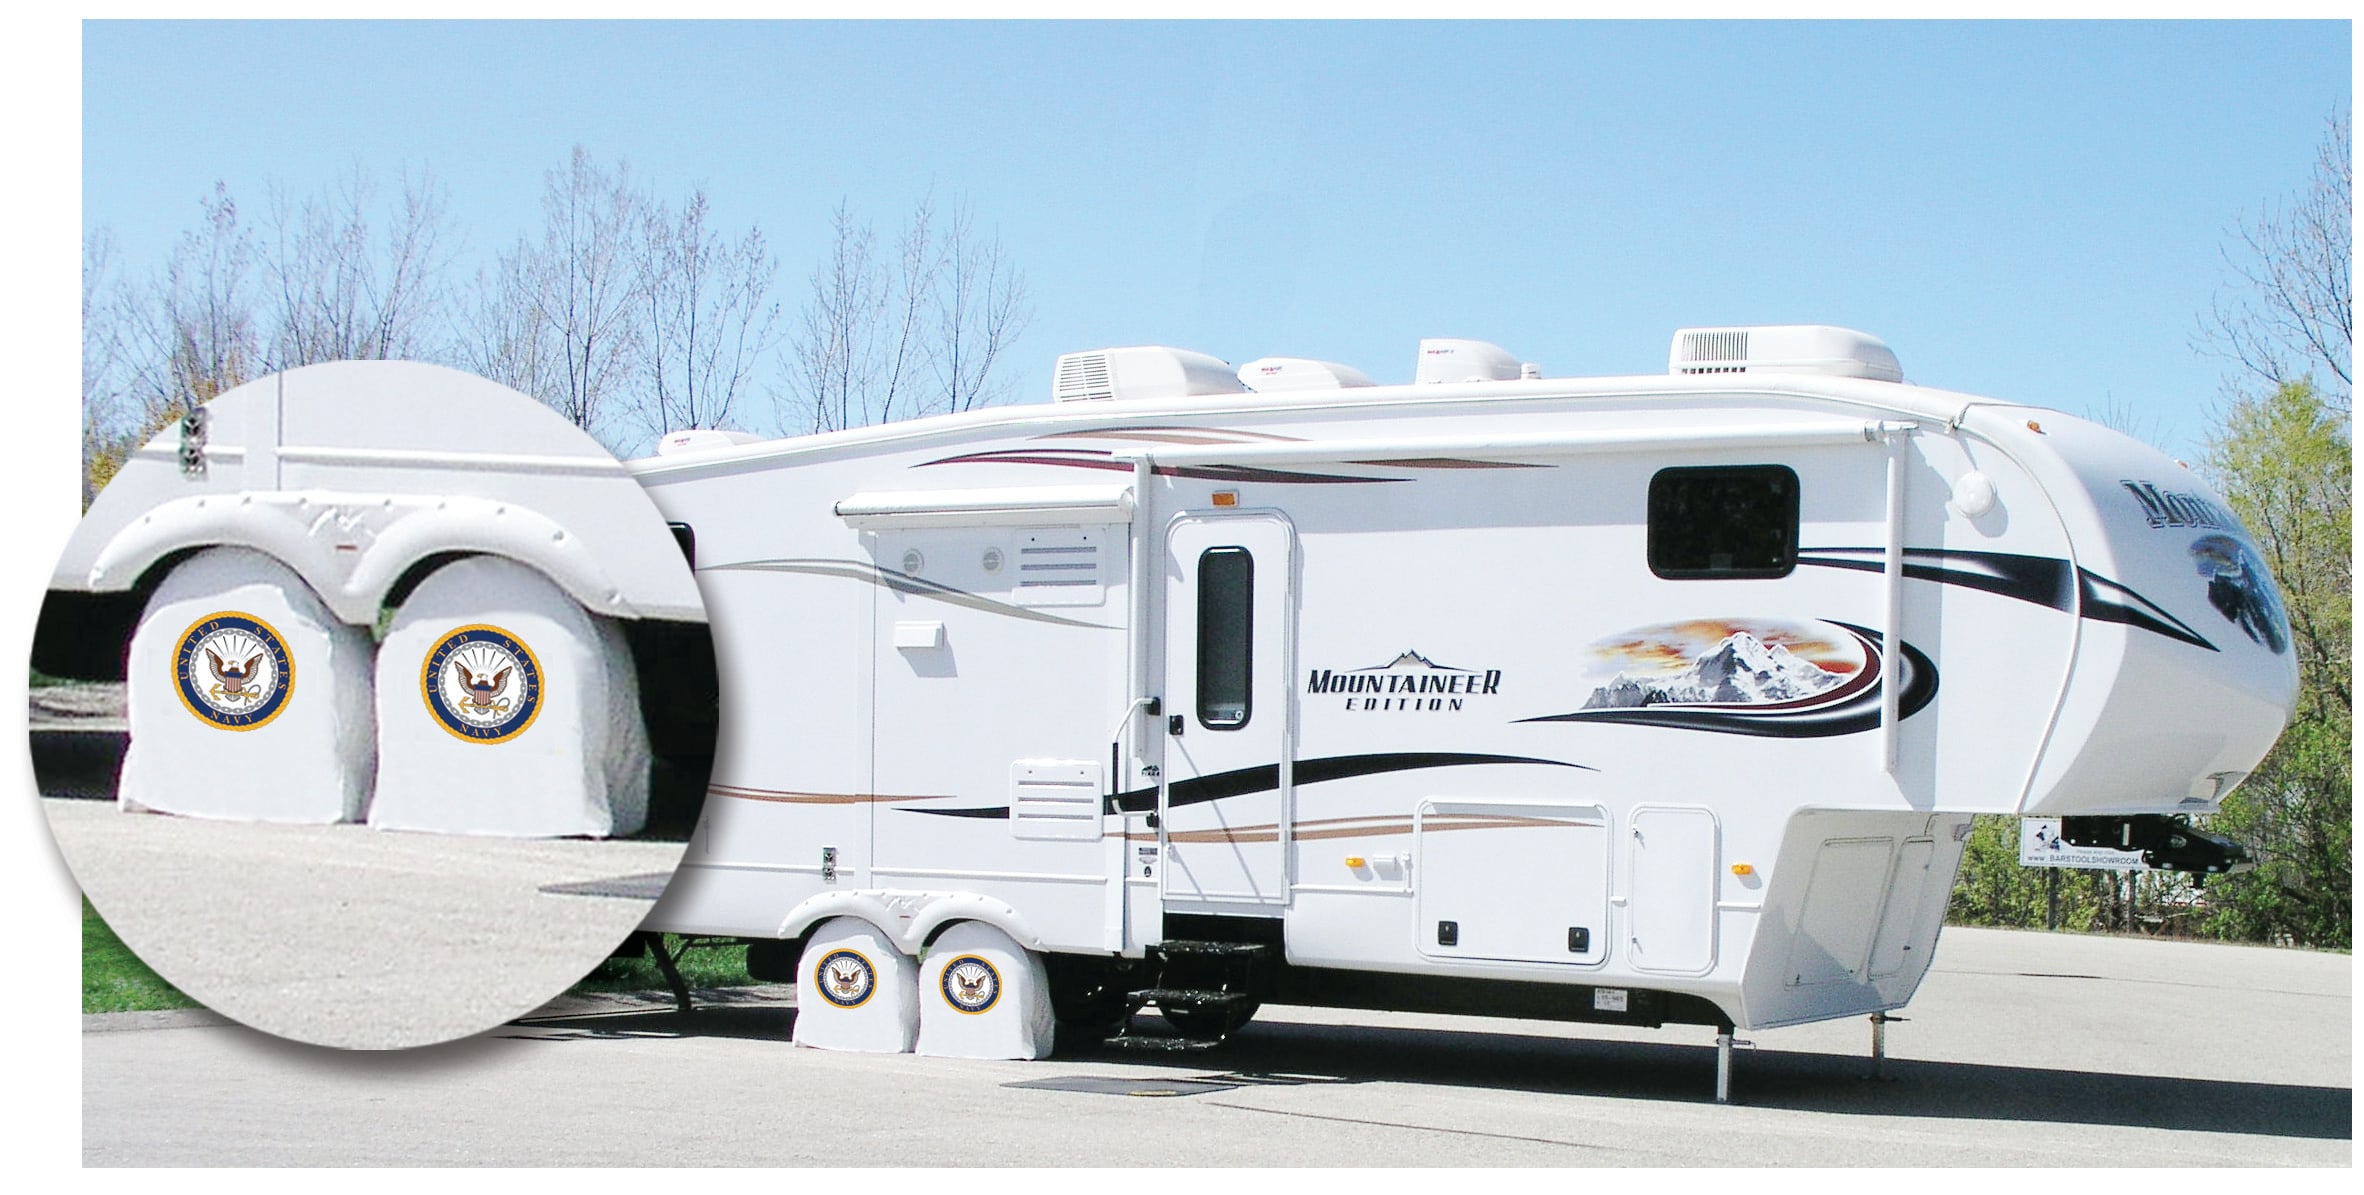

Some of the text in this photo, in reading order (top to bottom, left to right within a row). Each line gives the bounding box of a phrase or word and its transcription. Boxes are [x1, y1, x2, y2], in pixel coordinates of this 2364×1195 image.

[180, 621, 289, 690] UNITED STATES
[428, 634, 538, 703] UNITED STATES
[1307, 669, 1502, 695] MOUNTAINEER
[1345, 698, 1463, 712] EDITION
[211, 710, 253, 724] NAVY
[460, 723, 502, 737] NAVY
